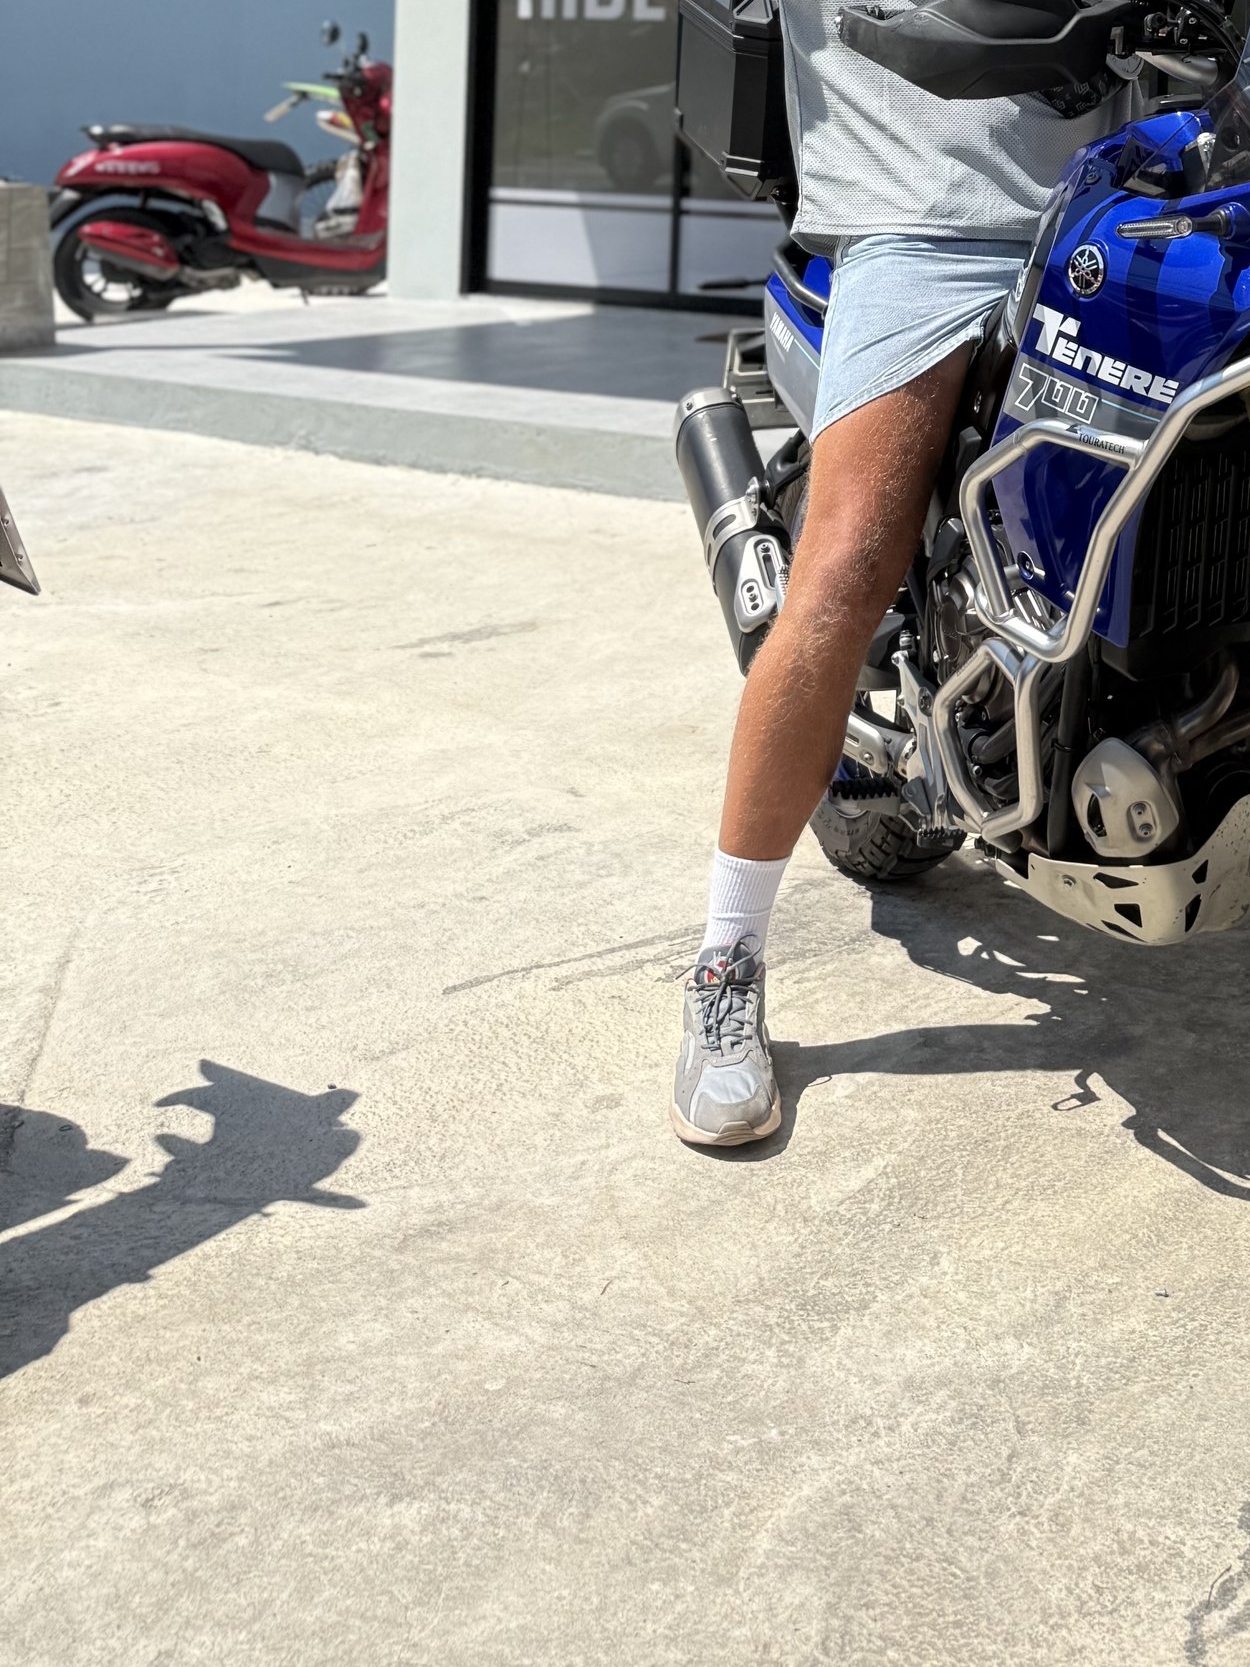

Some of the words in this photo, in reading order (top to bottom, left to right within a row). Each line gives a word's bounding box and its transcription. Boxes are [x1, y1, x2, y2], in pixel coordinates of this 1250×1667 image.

[769, 310, 795, 353] YAMAHA
[1014, 363, 1100, 425] 700
[1078, 433, 1126, 455] TOURATECH
